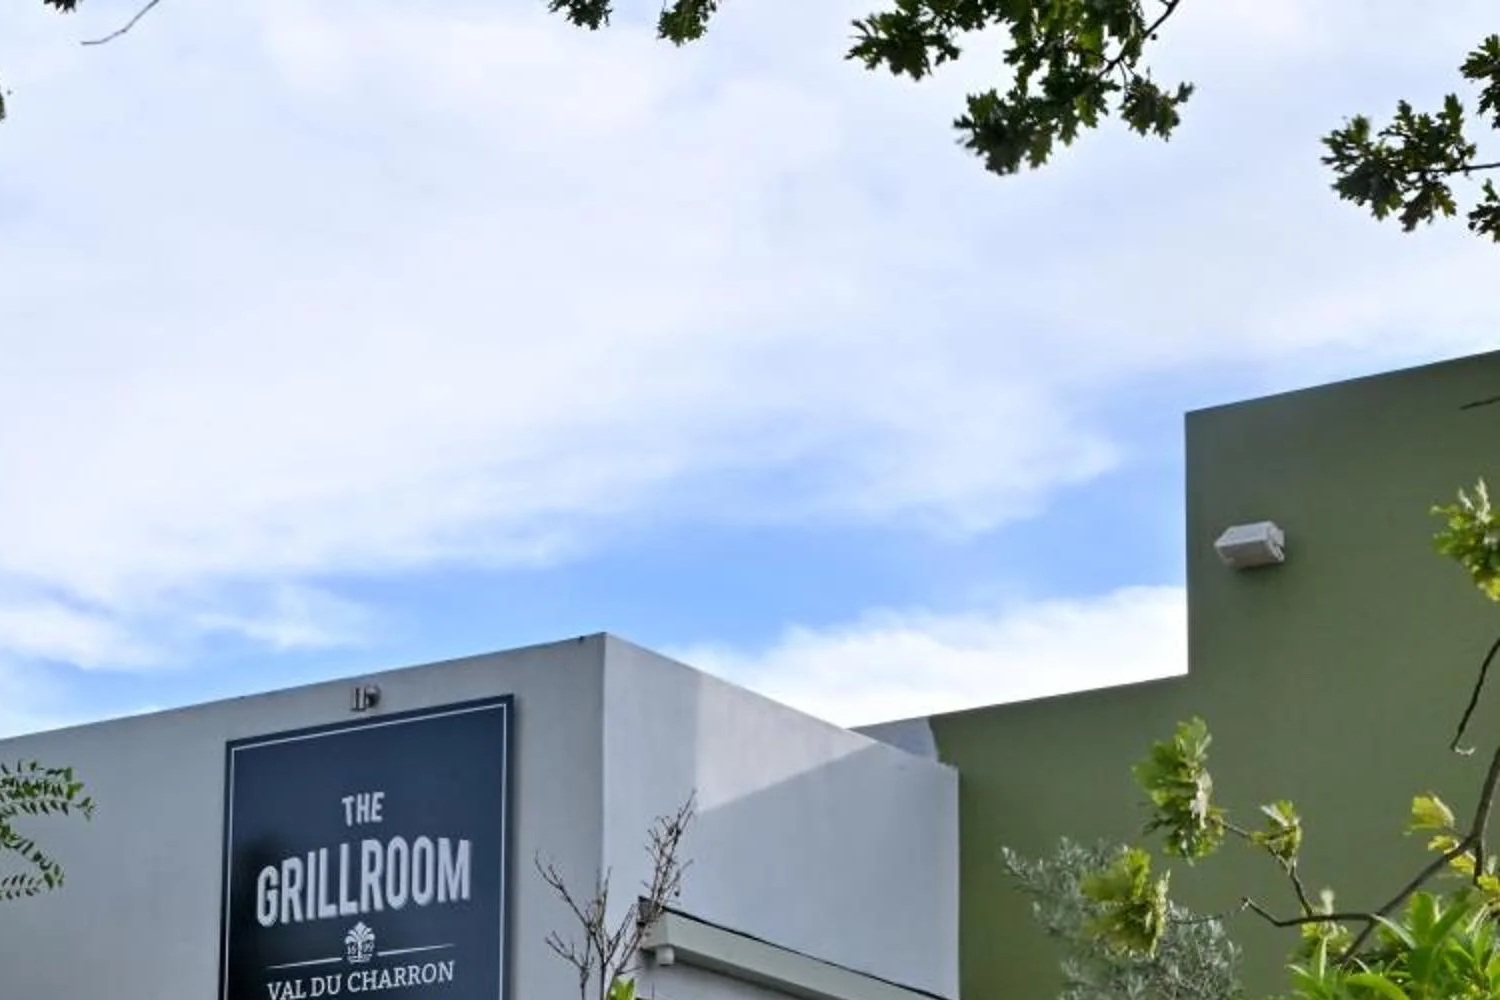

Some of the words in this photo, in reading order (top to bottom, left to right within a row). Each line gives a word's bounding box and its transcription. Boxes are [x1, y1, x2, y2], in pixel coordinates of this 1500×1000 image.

[341, 791, 385, 827] THE
[256, 836, 472, 927] GRILLROOM
[310, 973, 342, 997] DU
[347, 960, 455, 993] CHARRON
